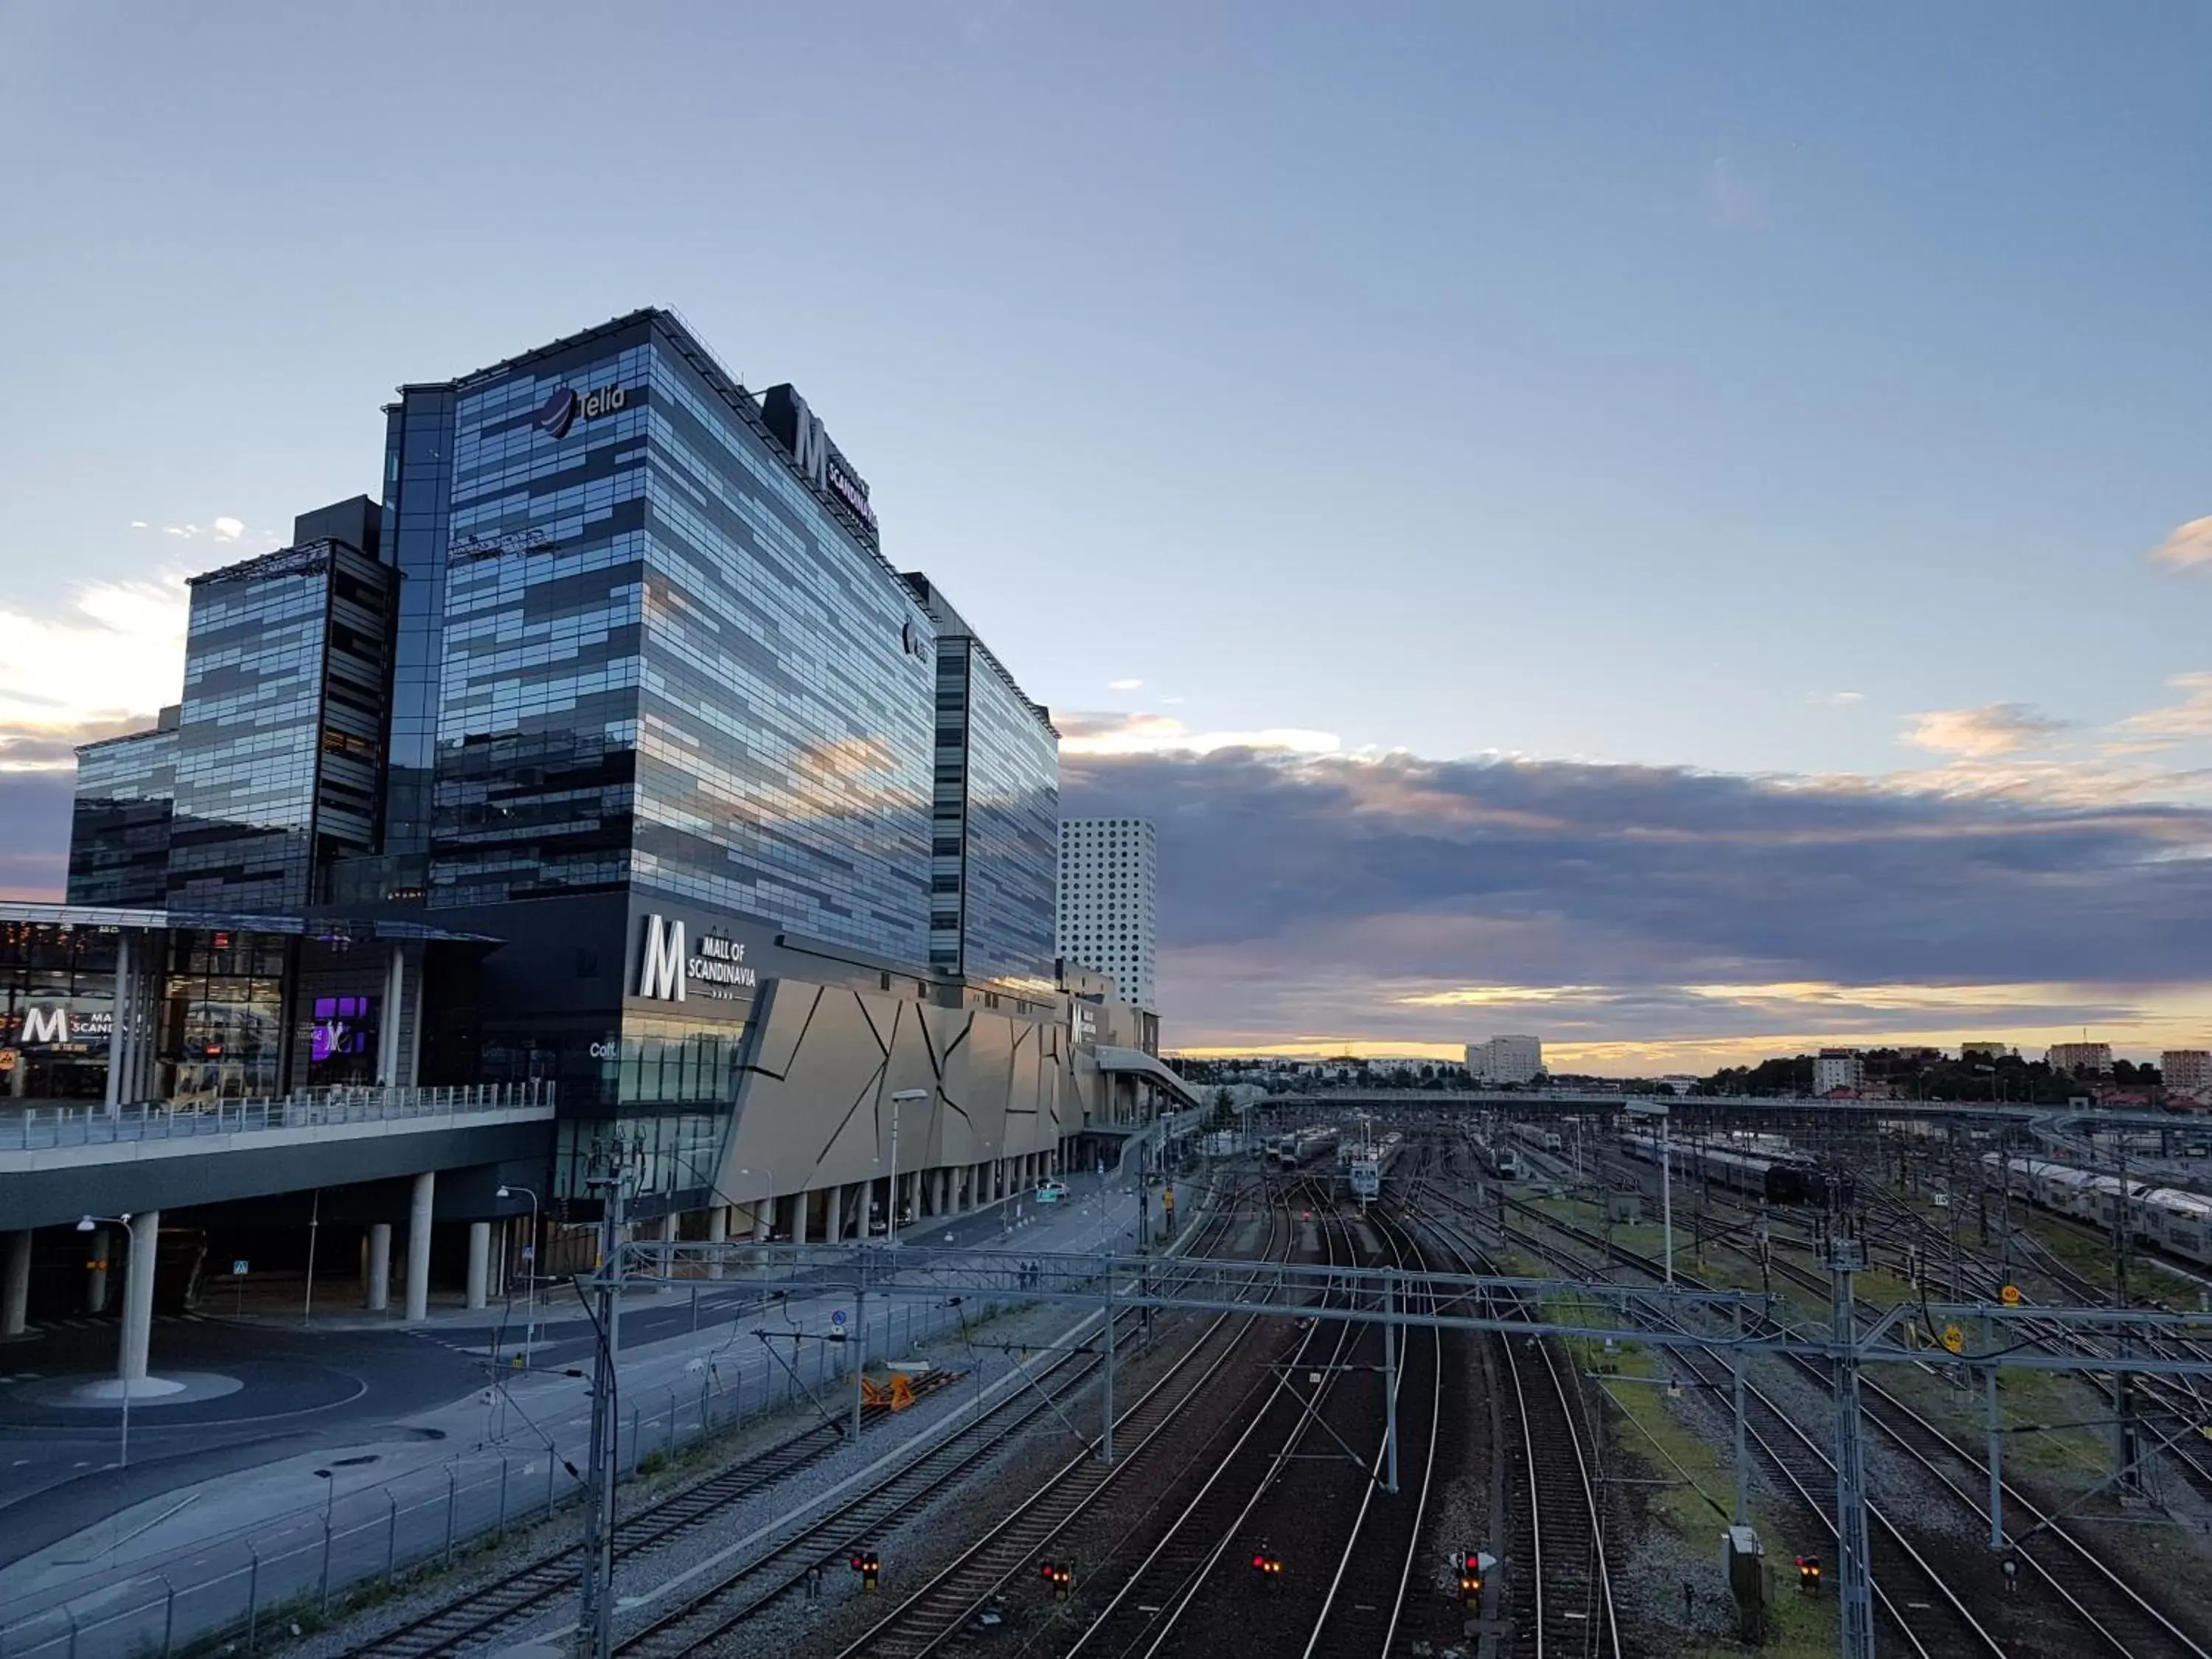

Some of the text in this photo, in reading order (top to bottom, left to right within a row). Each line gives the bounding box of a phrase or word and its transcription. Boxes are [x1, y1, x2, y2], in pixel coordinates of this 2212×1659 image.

[577, 384, 625, 420] Telia
[796, 398, 827, 491] M
[641, 914, 686, 1002] M
[703, 936, 745, 961] MALL OF
[688, 958, 756, 987] SCANDINAVIA
[21, 1007, 68, 1042] M
